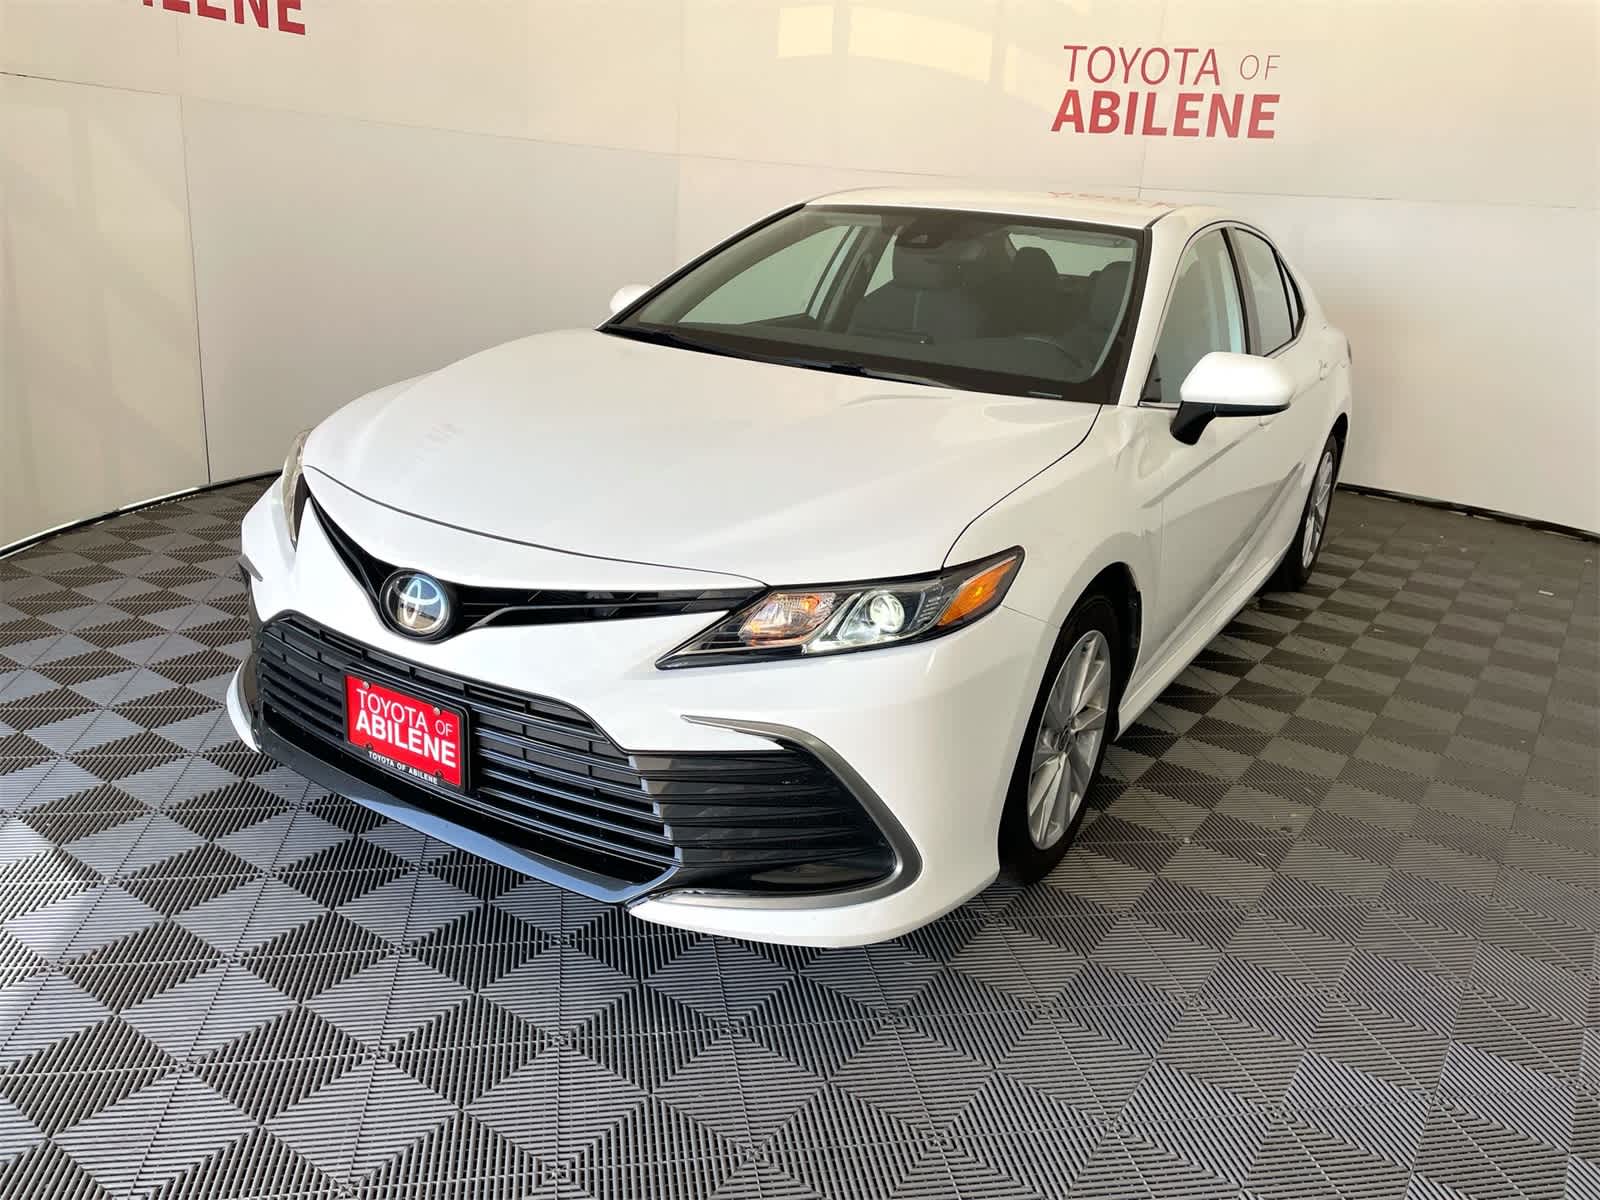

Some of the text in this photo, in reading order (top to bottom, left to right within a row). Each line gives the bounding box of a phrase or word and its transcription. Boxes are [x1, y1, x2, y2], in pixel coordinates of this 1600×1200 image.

[1064, 45, 1281, 86] TOYOTA OF
[1050, 89, 1281, 139] ABILENE
[356, 688, 453, 736] TOYOTA OF
[356, 709, 456, 768] ABILENE
[368, 751, 438, 785] TOYOTA OF ABILENE
